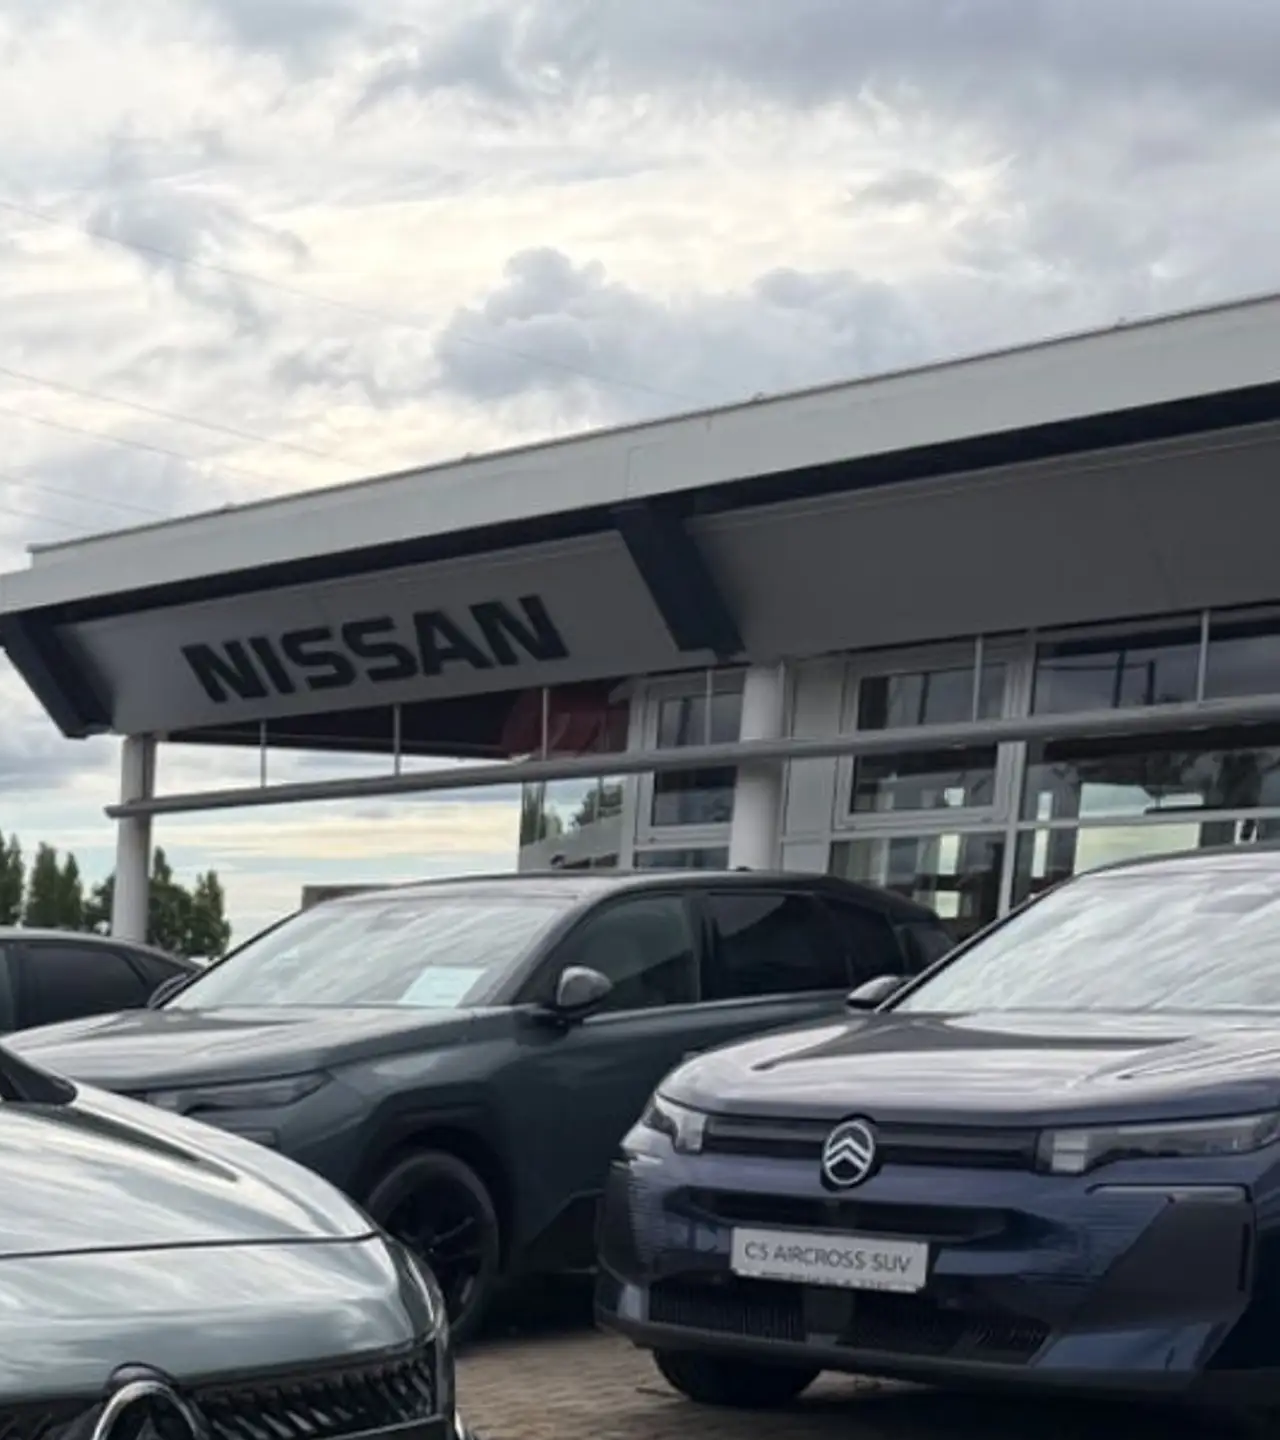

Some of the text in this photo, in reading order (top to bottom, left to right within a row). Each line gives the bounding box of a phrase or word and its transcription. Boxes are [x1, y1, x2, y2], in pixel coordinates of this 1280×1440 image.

[180, 595, 570, 703] NISSAN
[773, 1244, 867, 1271] AIRCROSS
[871, 1252, 912, 1274] SUV
